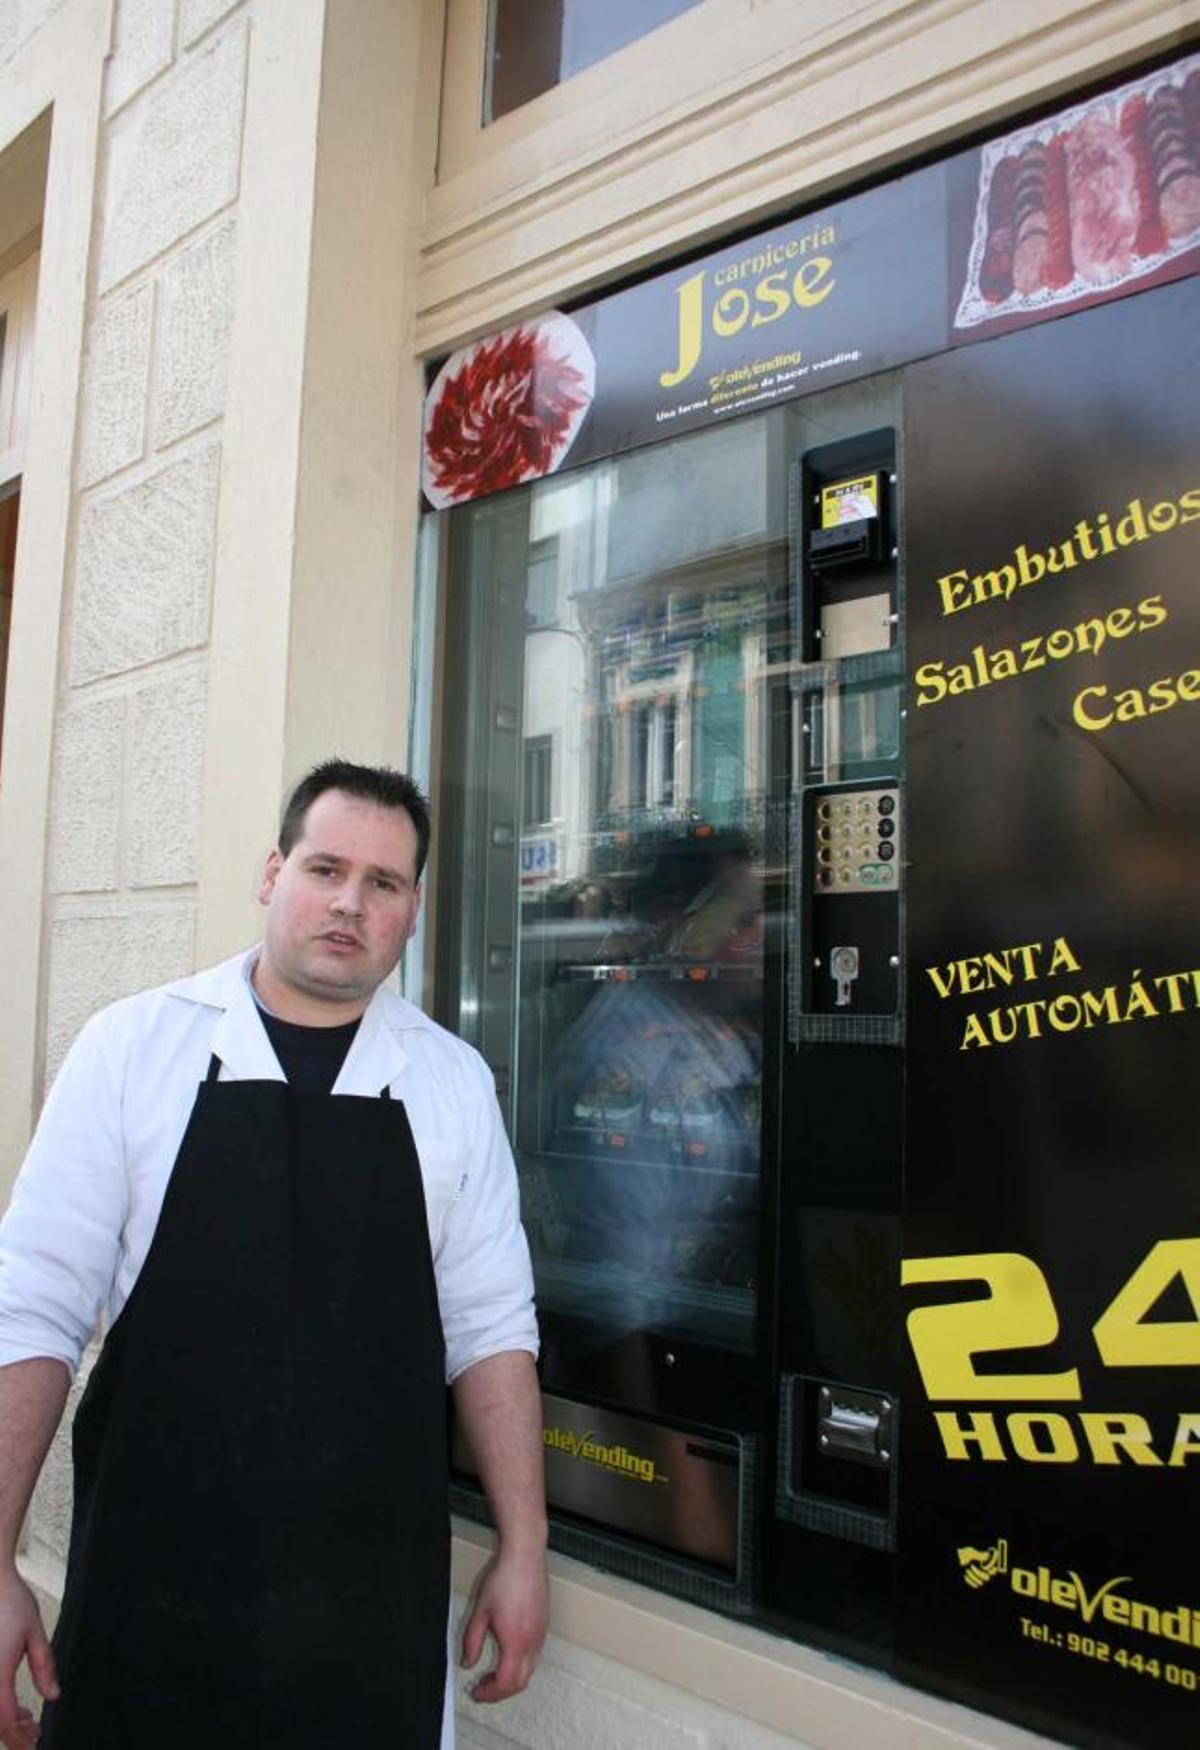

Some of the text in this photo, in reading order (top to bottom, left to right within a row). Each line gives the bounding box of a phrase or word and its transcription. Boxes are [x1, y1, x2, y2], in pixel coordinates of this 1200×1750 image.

[660, 257, 836, 387] Jose
[655, 409, 677, 422] Una
[760, 376, 775, 388] de
[937, 489, 1200, 617] Embutidos
[914, 595, 1168, 707] Salazones
[1072, 669, 1200, 731] Case
[925, 937, 1082, 998] VENTA
[900, 1237, 1200, 1401] 24
[933, 1411, 1200, 1467] HORA
[1020, 1617, 1200, 1690] Tel.: 902 444 00
